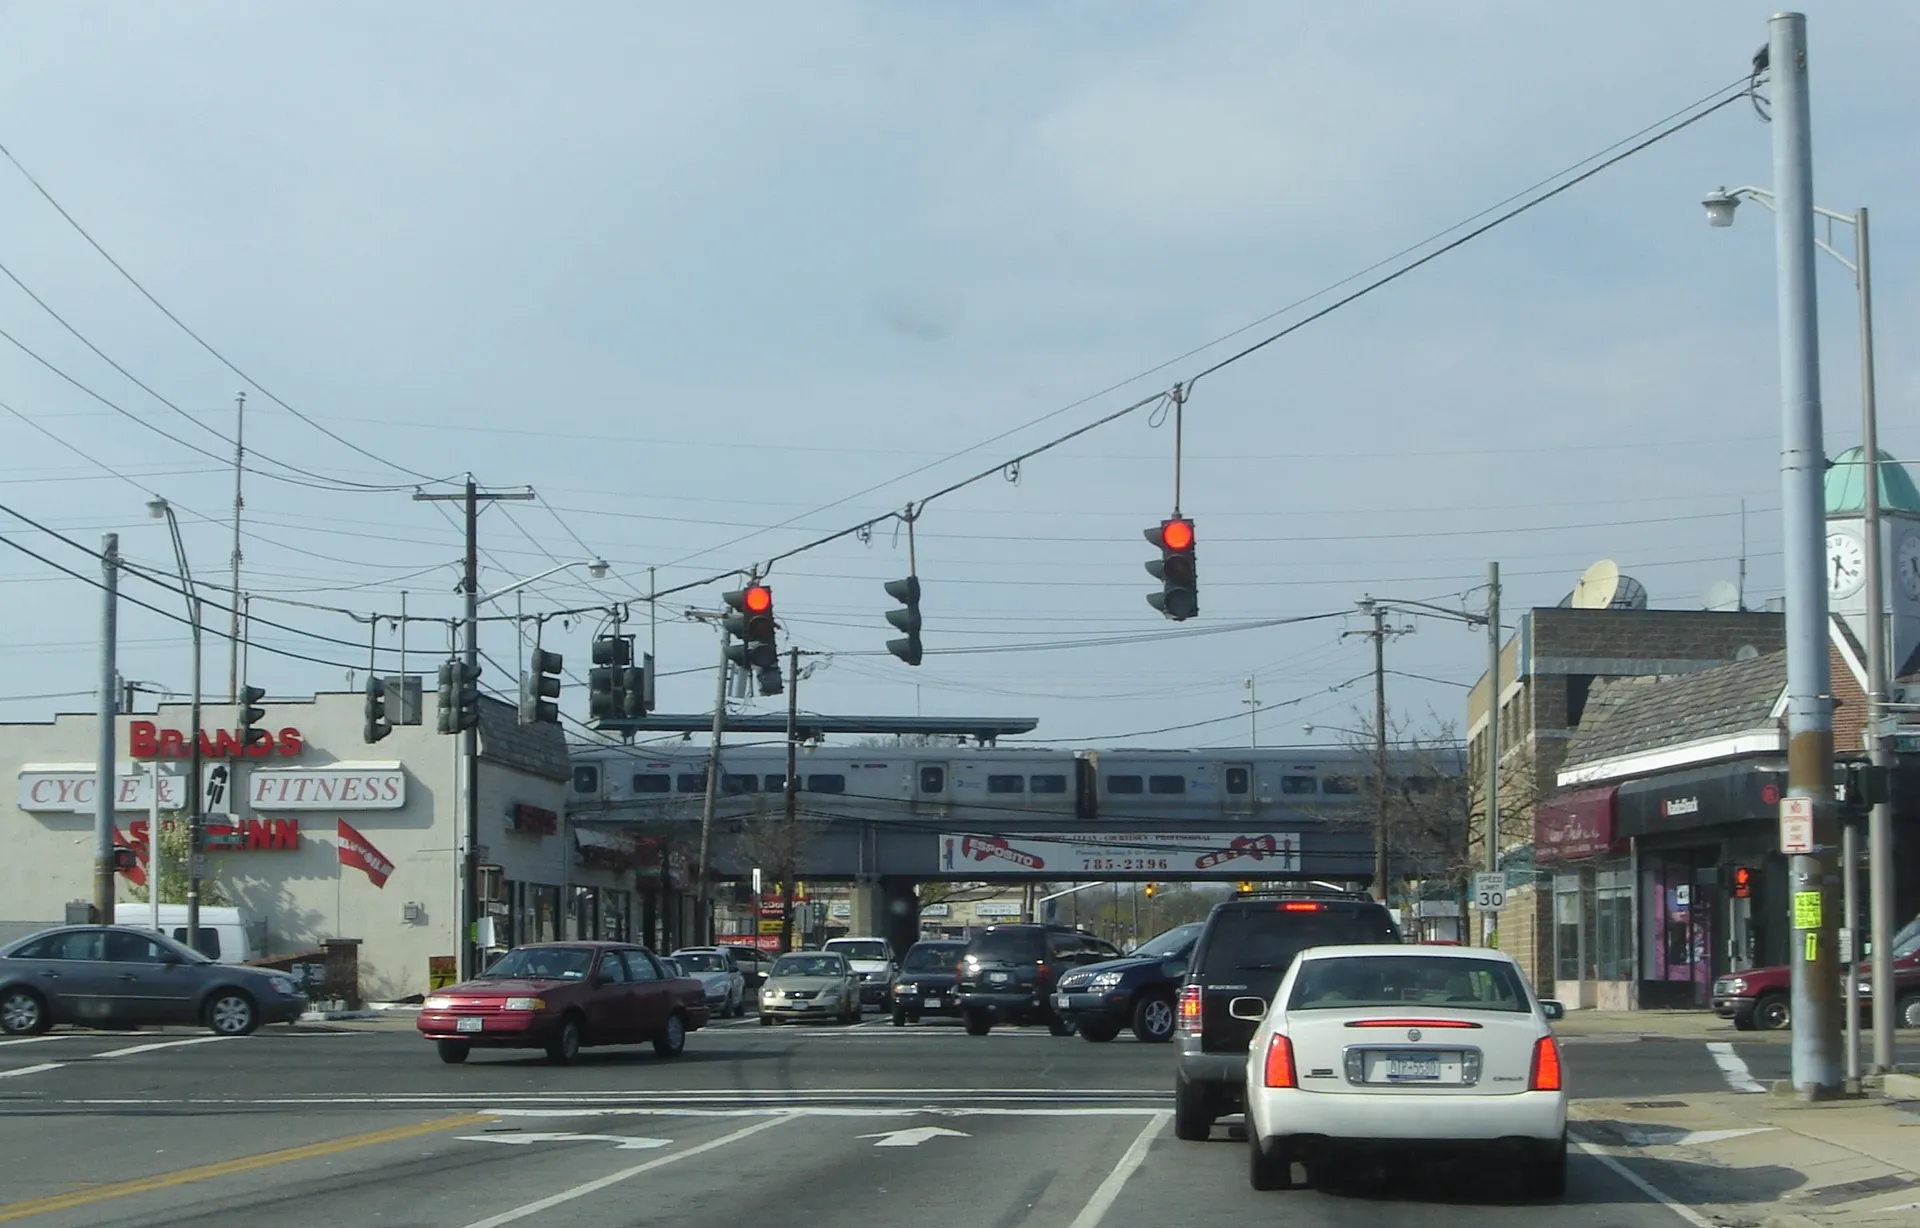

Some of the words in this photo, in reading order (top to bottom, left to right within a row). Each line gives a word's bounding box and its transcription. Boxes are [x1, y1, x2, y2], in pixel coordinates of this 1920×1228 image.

[31, 778, 140, 803] CYCE
[254, 776, 400, 801] FITNESS
[968, 838, 1034, 867] ESPOSITO
[1082, 858, 1168, 870] 785-2396
[1478, 875, 1503, 883] SPEED
[1479, 892, 1503, 906] 30
